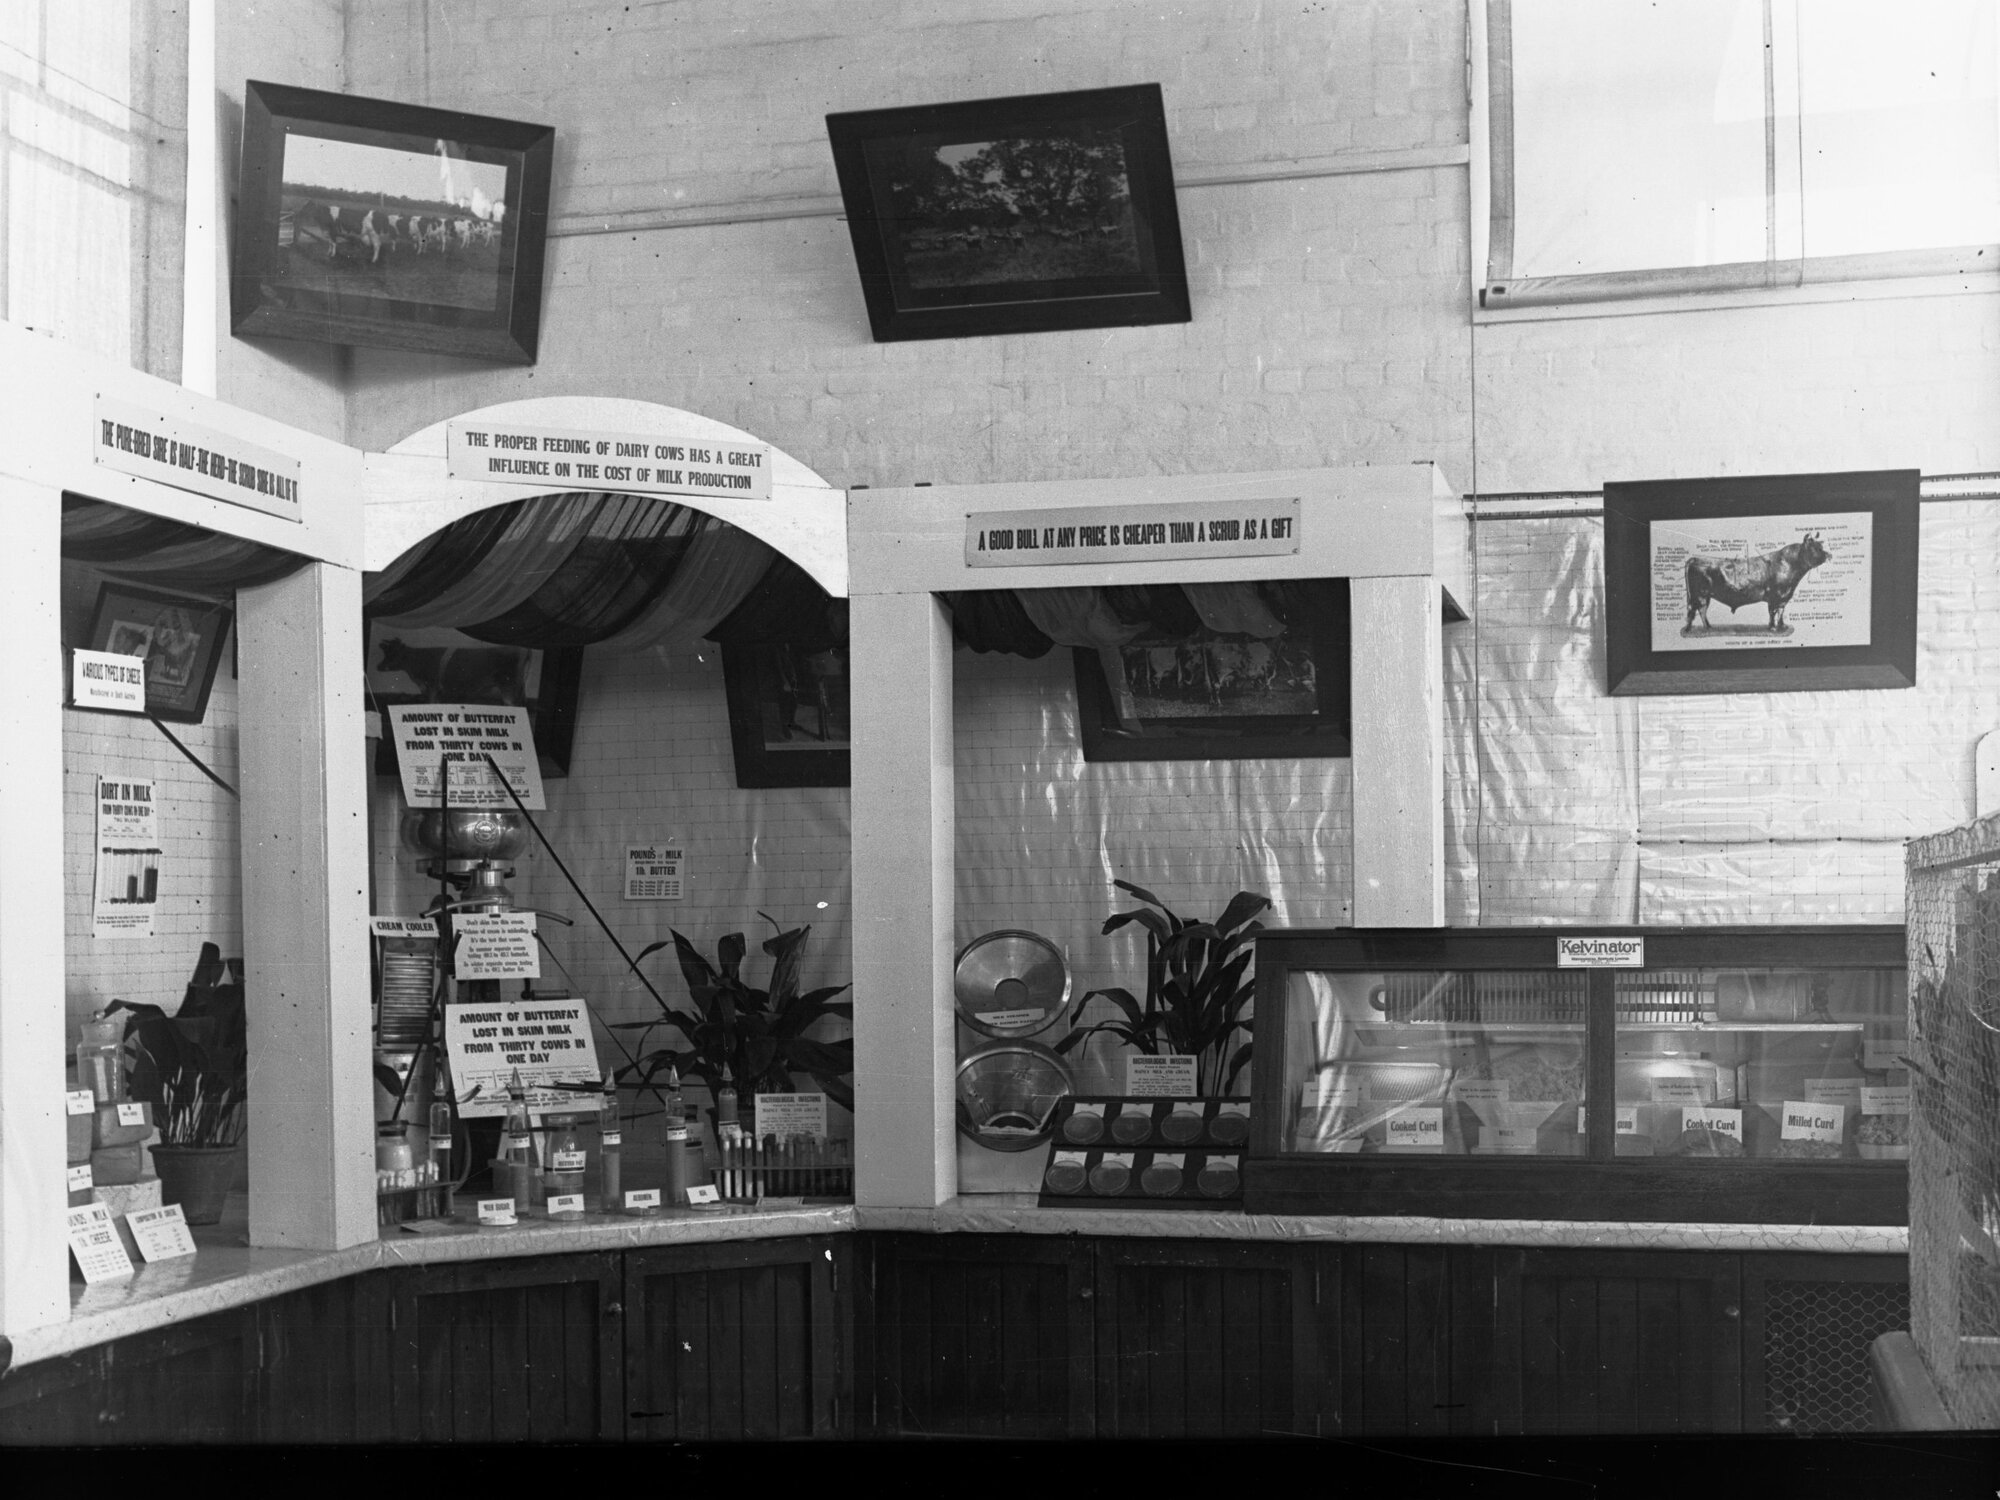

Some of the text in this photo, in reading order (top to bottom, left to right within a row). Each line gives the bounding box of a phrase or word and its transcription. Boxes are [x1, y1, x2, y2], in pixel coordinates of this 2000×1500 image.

[466, 432, 761, 467] THE PROPER FEEDING OF DAIRY COWS HAS A GREAT
[102, 419, 114, 447] THE
[117, 424, 150, 458] PURE-BRED
[153, 436, 168, 463] SIRE
[170, 440, 177, 465] IS
[179, 443, 196, 470] HALF
[269, 473, 274, 496] IS
[292, 481, 297, 504] IT
[489, 458, 751, 489] INFLUENCE ON THE COST OF MILK PRODUCTION
[978, 517, 1292, 551] A GOOD BULL AT ANY PRICE IS CHEAPER THAN A SCRUB AS A GIFT
[402, 713, 516, 724] AMOUNT OF BUTTERFAT
[414, 727, 509, 737] LOST IN SKIM MILK
[406, 741, 522, 750] FROM THIRTY COWS IN
[447, 752, 488, 762] ONE DAY
[102, 782, 151, 802] DIRT IN MILK
[630, 850, 656, 859] POUNDS
[666, 850, 682, 859] MILK
[650, 866, 676, 875] BUTTER
[377, 922, 434, 931] CREAM COOLER
[1561, 940, 1640, 953] Kelvinator
[460, 1010, 579, 1023] AMOUNT OF BUTTERFAT
[472, 1025, 572, 1038] LOST IN SKIM MILK
[464, 1039, 586, 1053] FROM THIRTY COWS IN
[506, 1053, 550, 1064] ONE DAY
[1390, 1120, 1437, 1132] Cooked Curd
[1686, 1119, 1735, 1130] Cooked Curd
[1788, 1114, 1834, 1130] Milled Curd
